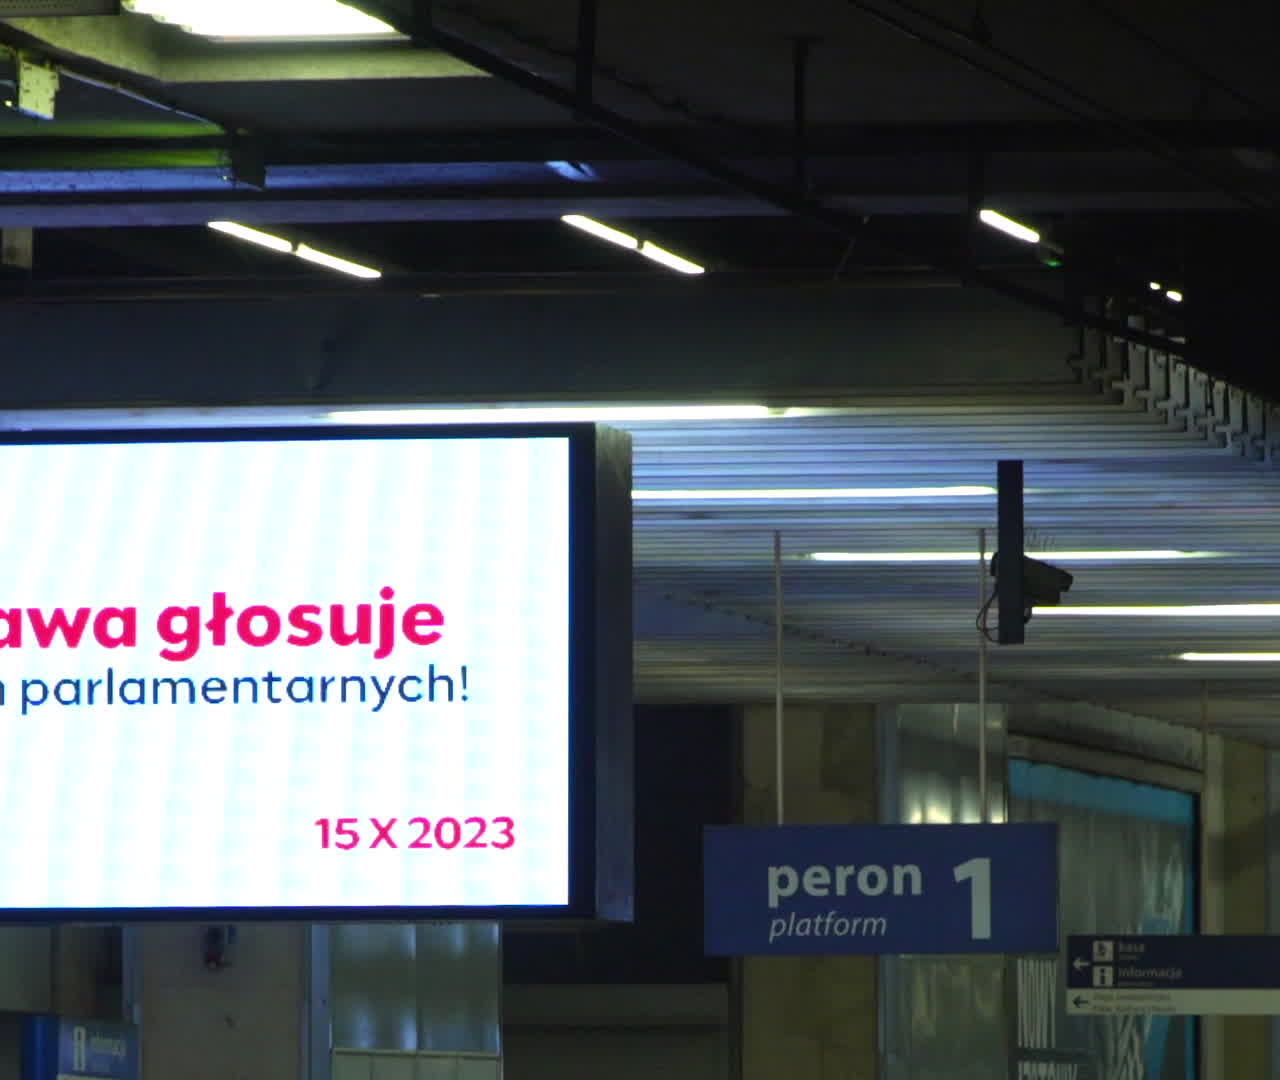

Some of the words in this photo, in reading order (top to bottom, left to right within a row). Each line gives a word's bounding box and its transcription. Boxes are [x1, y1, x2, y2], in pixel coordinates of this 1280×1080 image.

[157, 586, 445, 661] głosuje
[21, 666, 468, 715] parlamentarnych!
[316, 818, 360, 850] 15
[369, 818, 399, 849] X
[408, 816, 516, 850] 2023
[768, 864, 922, 908] peron
[953, 858, 991, 940] 1
[768, 909, 888, 943] platform
